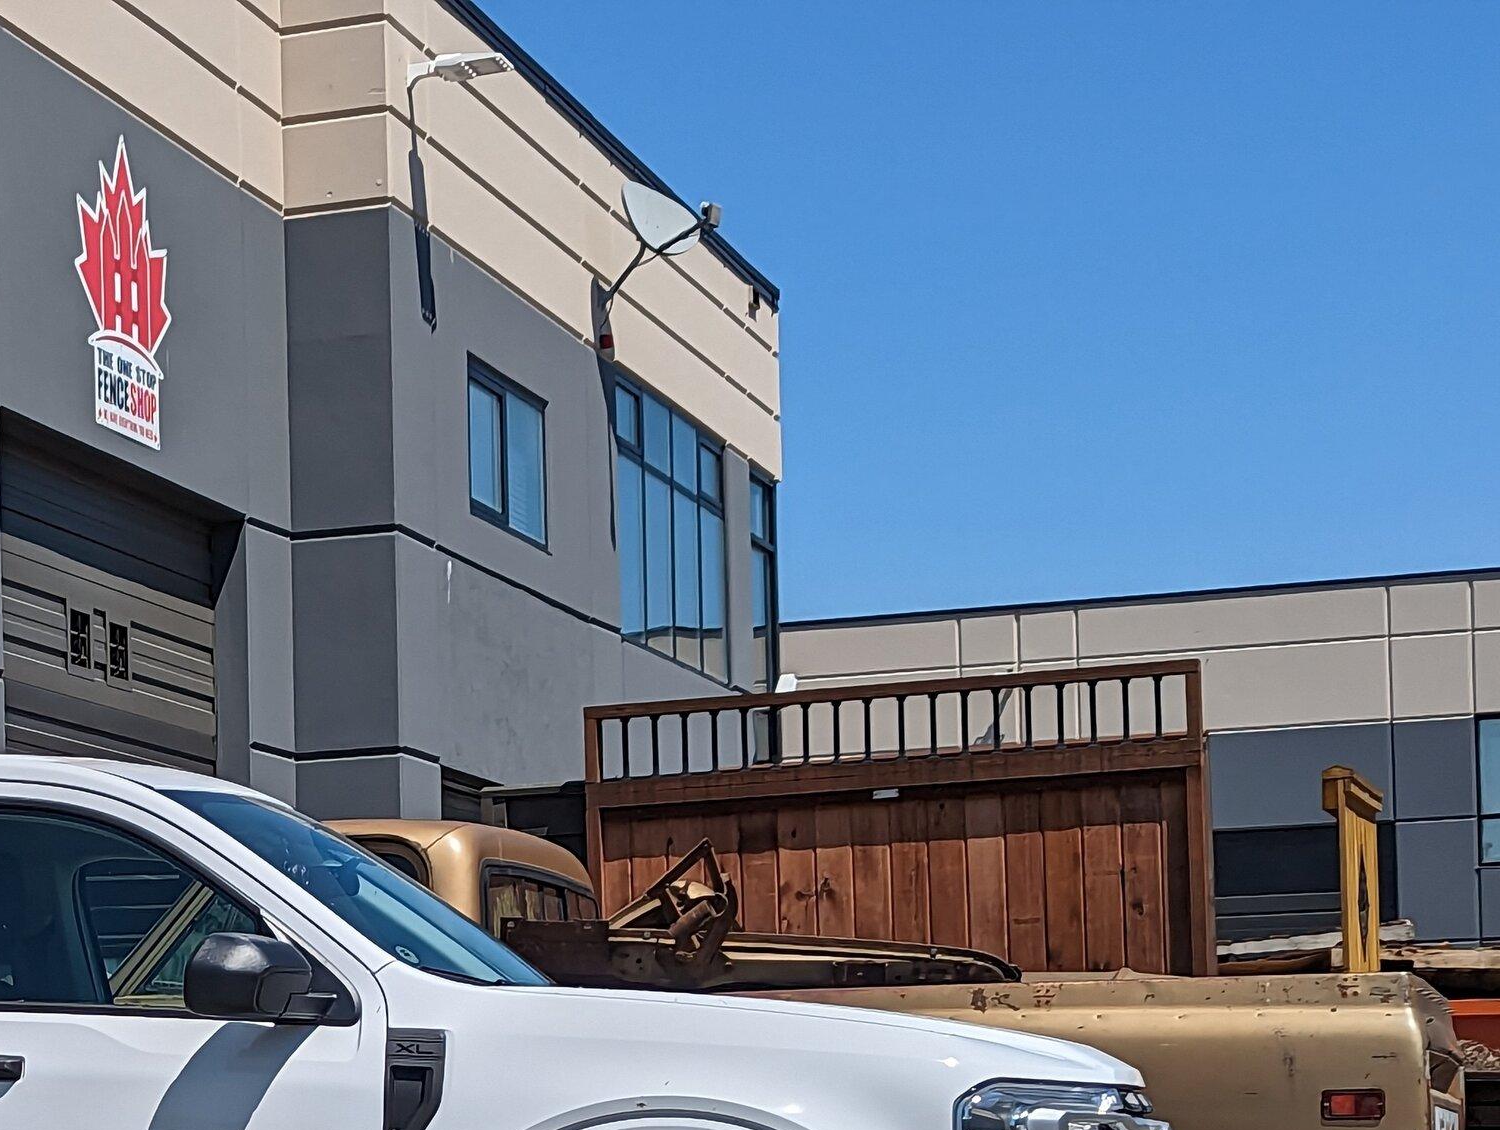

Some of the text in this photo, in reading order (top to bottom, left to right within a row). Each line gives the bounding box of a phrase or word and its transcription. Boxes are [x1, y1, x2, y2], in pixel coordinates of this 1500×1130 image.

[97, 347, 156, 390] THE ONE STOP
[396, 1043, 434, 1054] XL
